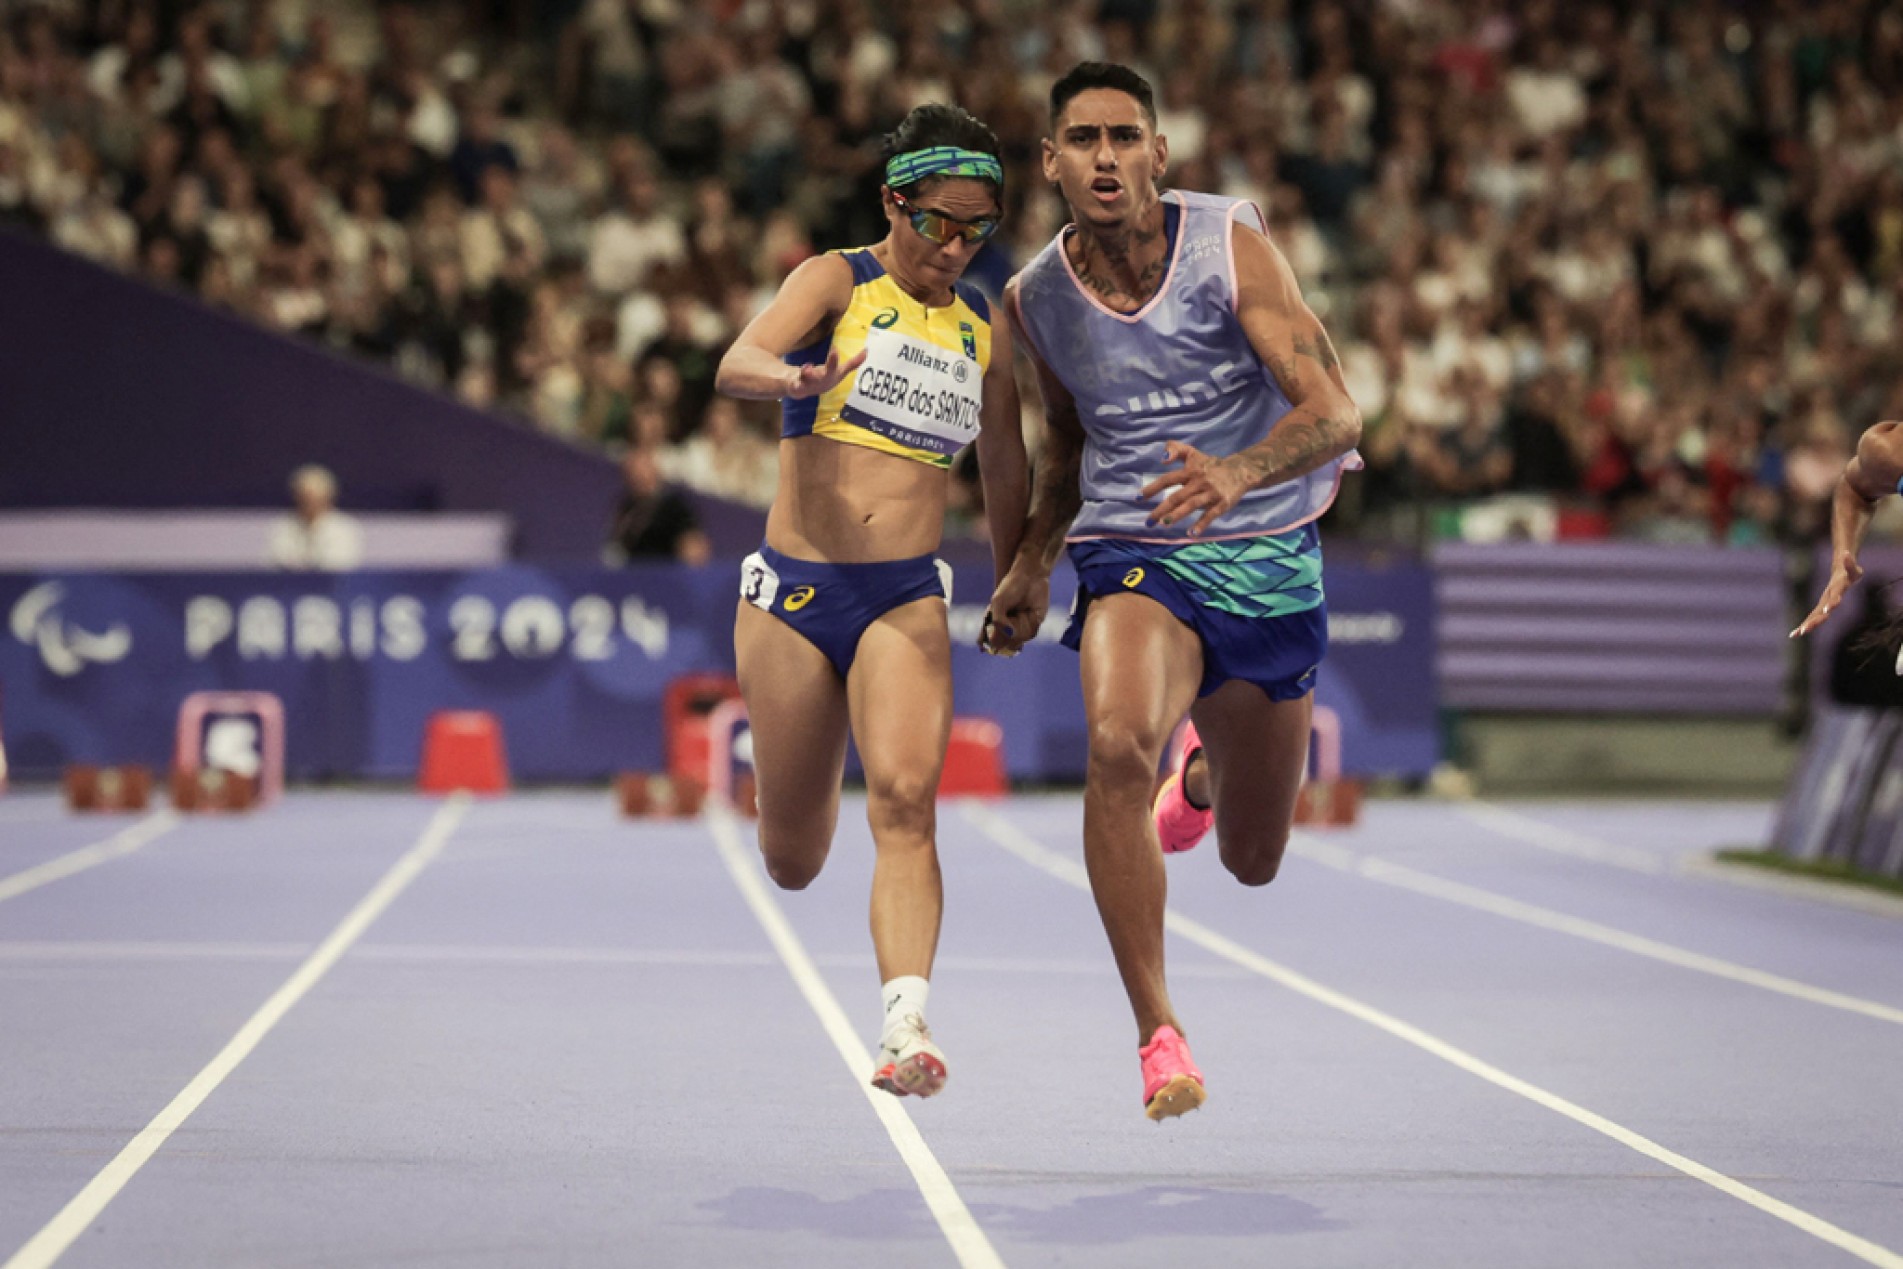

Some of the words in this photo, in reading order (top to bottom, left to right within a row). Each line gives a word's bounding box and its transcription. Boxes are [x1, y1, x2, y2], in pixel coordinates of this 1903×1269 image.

[897, 343, 949, 374] Allianz
[908, 382, 935, 418] dos
[889, 427, 920, 445] PARIS
[745, 566, 765, 602] 3
[184, 594, 427, 661] PARIS
[448, 594, 669, 661] 2024
